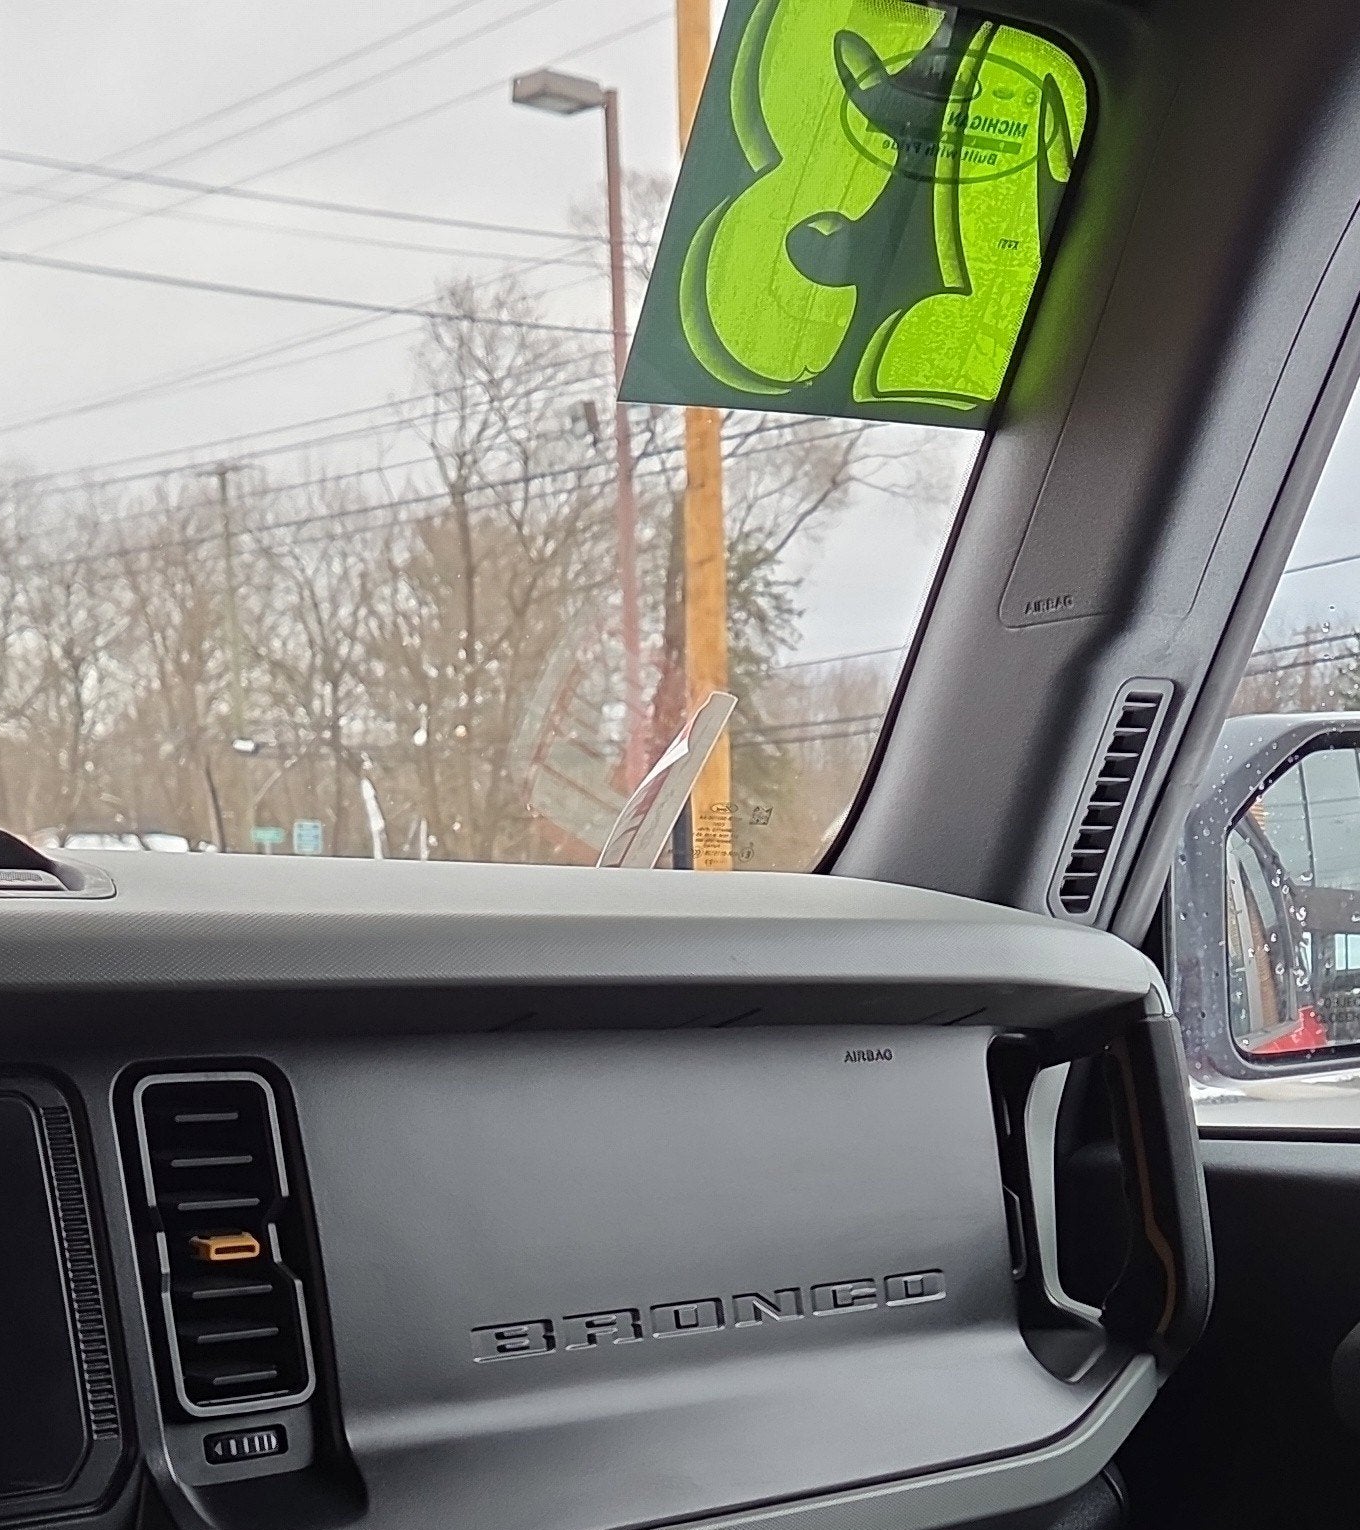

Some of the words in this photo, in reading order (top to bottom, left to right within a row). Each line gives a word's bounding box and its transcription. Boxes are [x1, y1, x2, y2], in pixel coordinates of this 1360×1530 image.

[1024, 595, 1074, 615] AIRBAG
[843, 1048, 893, 1063] AIRBAG
[471, 1268, 946, 1364] BRONCO
